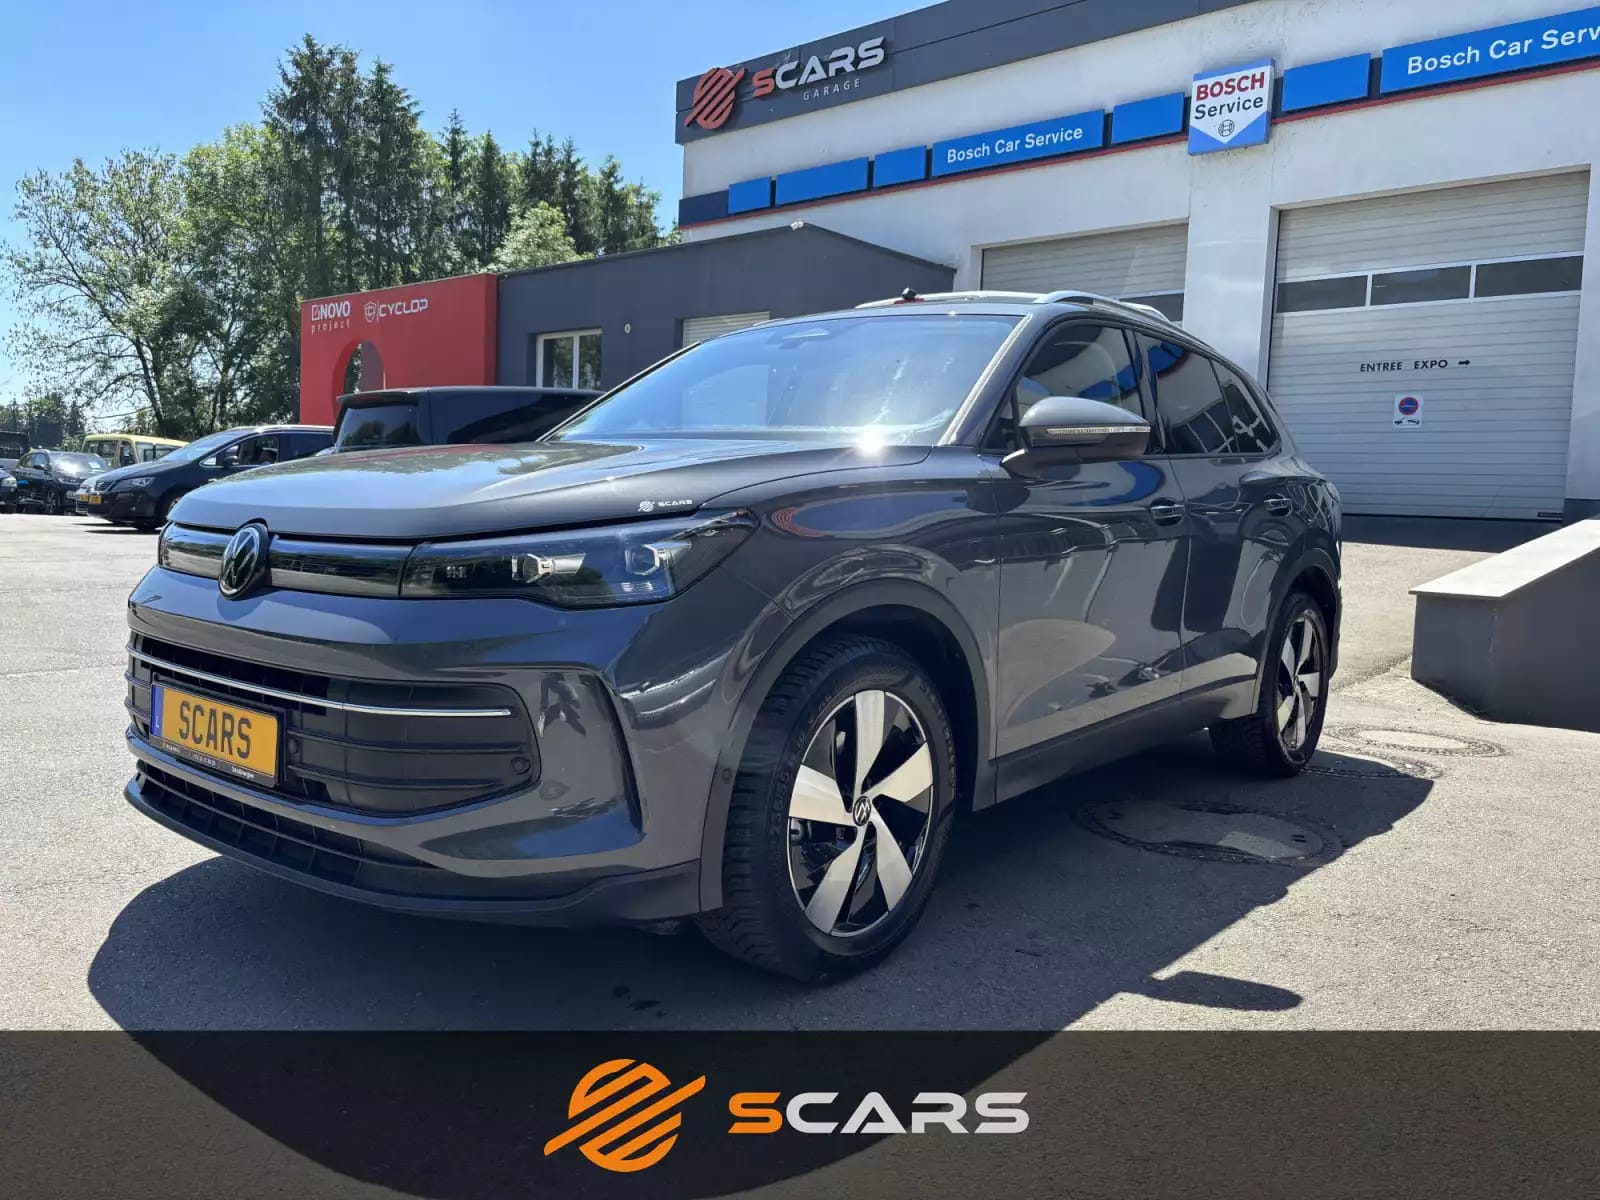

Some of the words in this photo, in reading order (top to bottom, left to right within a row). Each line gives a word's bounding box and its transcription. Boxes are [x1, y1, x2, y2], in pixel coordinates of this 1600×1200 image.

[1407, 45, 1480, 75] Bosch
[1489, 39, 1533, 60] Car
[1540, 26, 1600, 50] Serv
[752, 36, 885, 98] SCARS
[803, 78, 861, 101] GARAGE
[1196, 71, 1265, 102] BOSCH
[1194, 96, 1264, 120] Service
[947, 142, 991, 164] Bosch
[994, 139, 1021, 154] Car
[1024, 127, 1084, 149] Service
[379, 298, 429, 318] CYCLOP
[311, 319, 350, 335] project
[1360, 361, 1403, 373] ENTREE
[1414, 359, 1448, 370] EXPO
[657, 499, 693, 507] SCARS
[178, 700, 252, 760] SCARS
